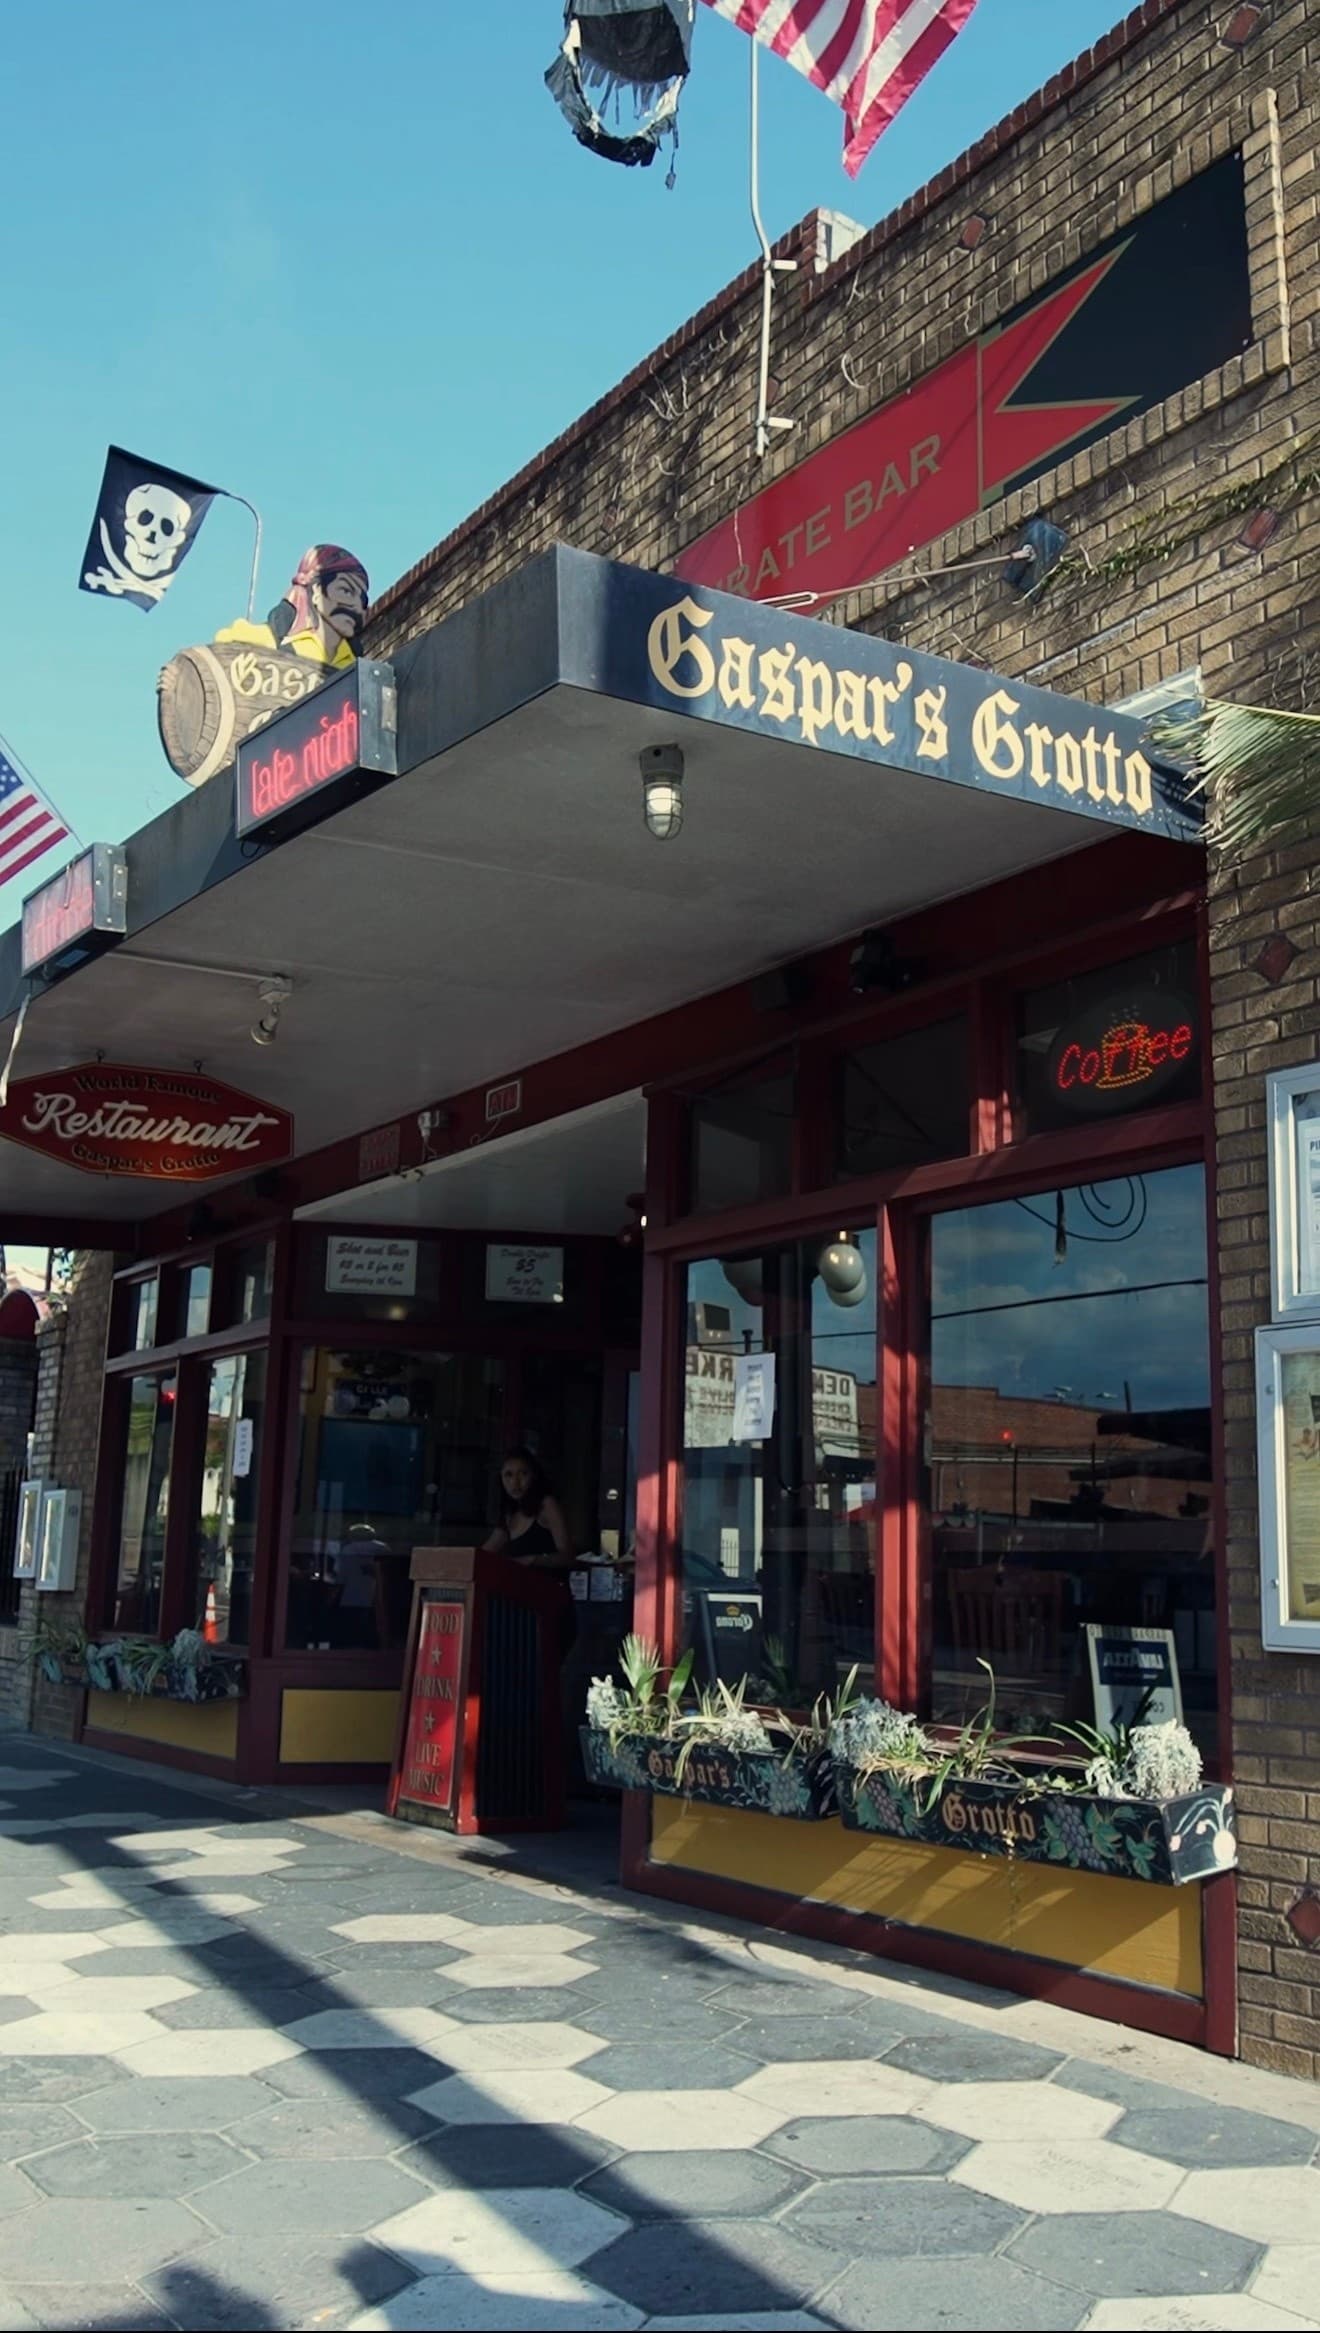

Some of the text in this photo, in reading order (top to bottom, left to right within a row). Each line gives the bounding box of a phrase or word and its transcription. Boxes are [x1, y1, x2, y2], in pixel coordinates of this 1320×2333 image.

[715, 434, 941, 596] RATE BAR
[648, 596, 1153, 816] Gaspar's Grotto
[252, 749, 300, 817] late
[22, 1092, 280, 1150] Restaurant
[515, 1258, 536, 1273] $5
[415, 1675, 454, 1700] DRINK
[415, 1741, 441, 1767] LIVE
[648, 1750, 730, 1789] Gapar's
[408, 1768, 444, 1797] MUSIC
[942, 1792, 1036, 1841] Grotto
